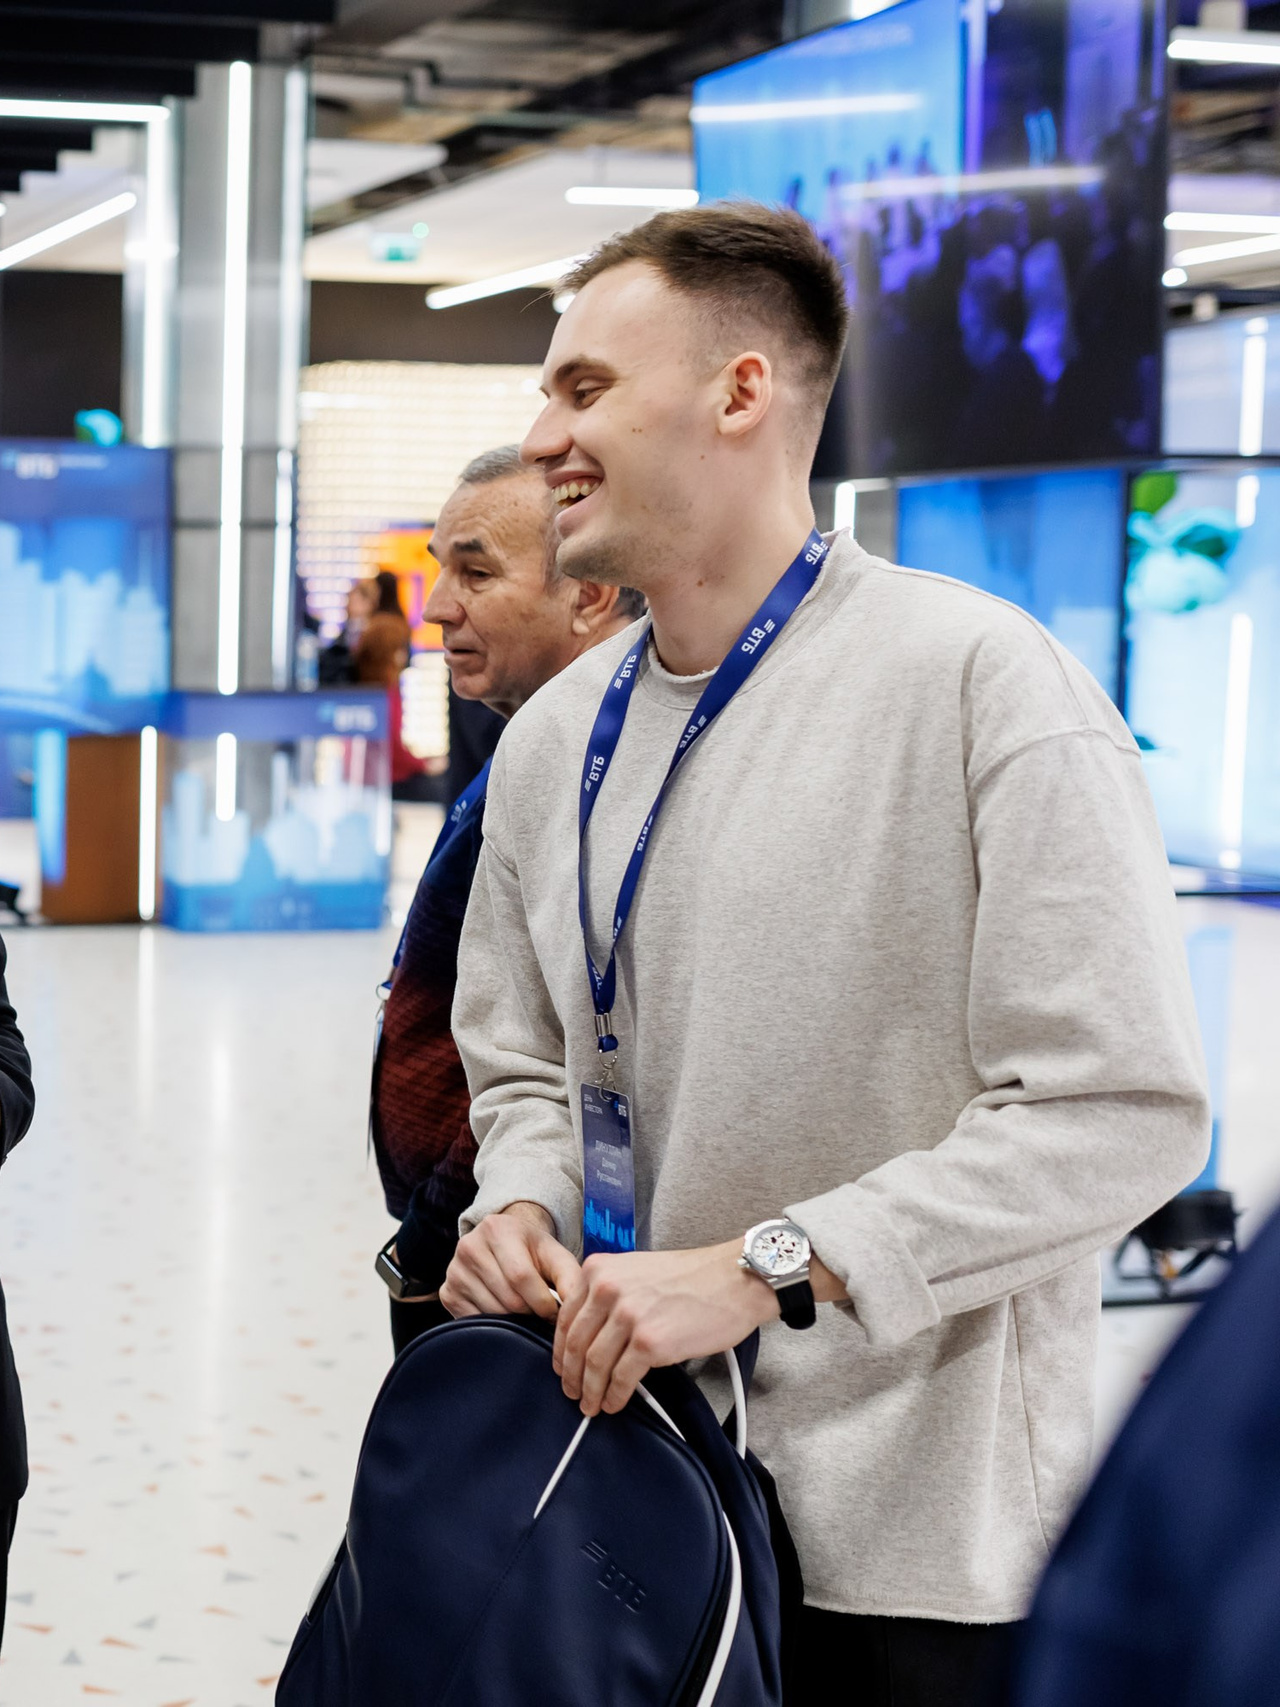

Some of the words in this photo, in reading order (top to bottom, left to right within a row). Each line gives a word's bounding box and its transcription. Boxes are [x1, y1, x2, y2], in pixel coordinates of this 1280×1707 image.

[805, 542, 825, 566] ВТБ
[740, 626, 767, 655] ВТБ
[619, 654, 638, 678] ВТБ
[588, 755, 605, 782] ВТБ
